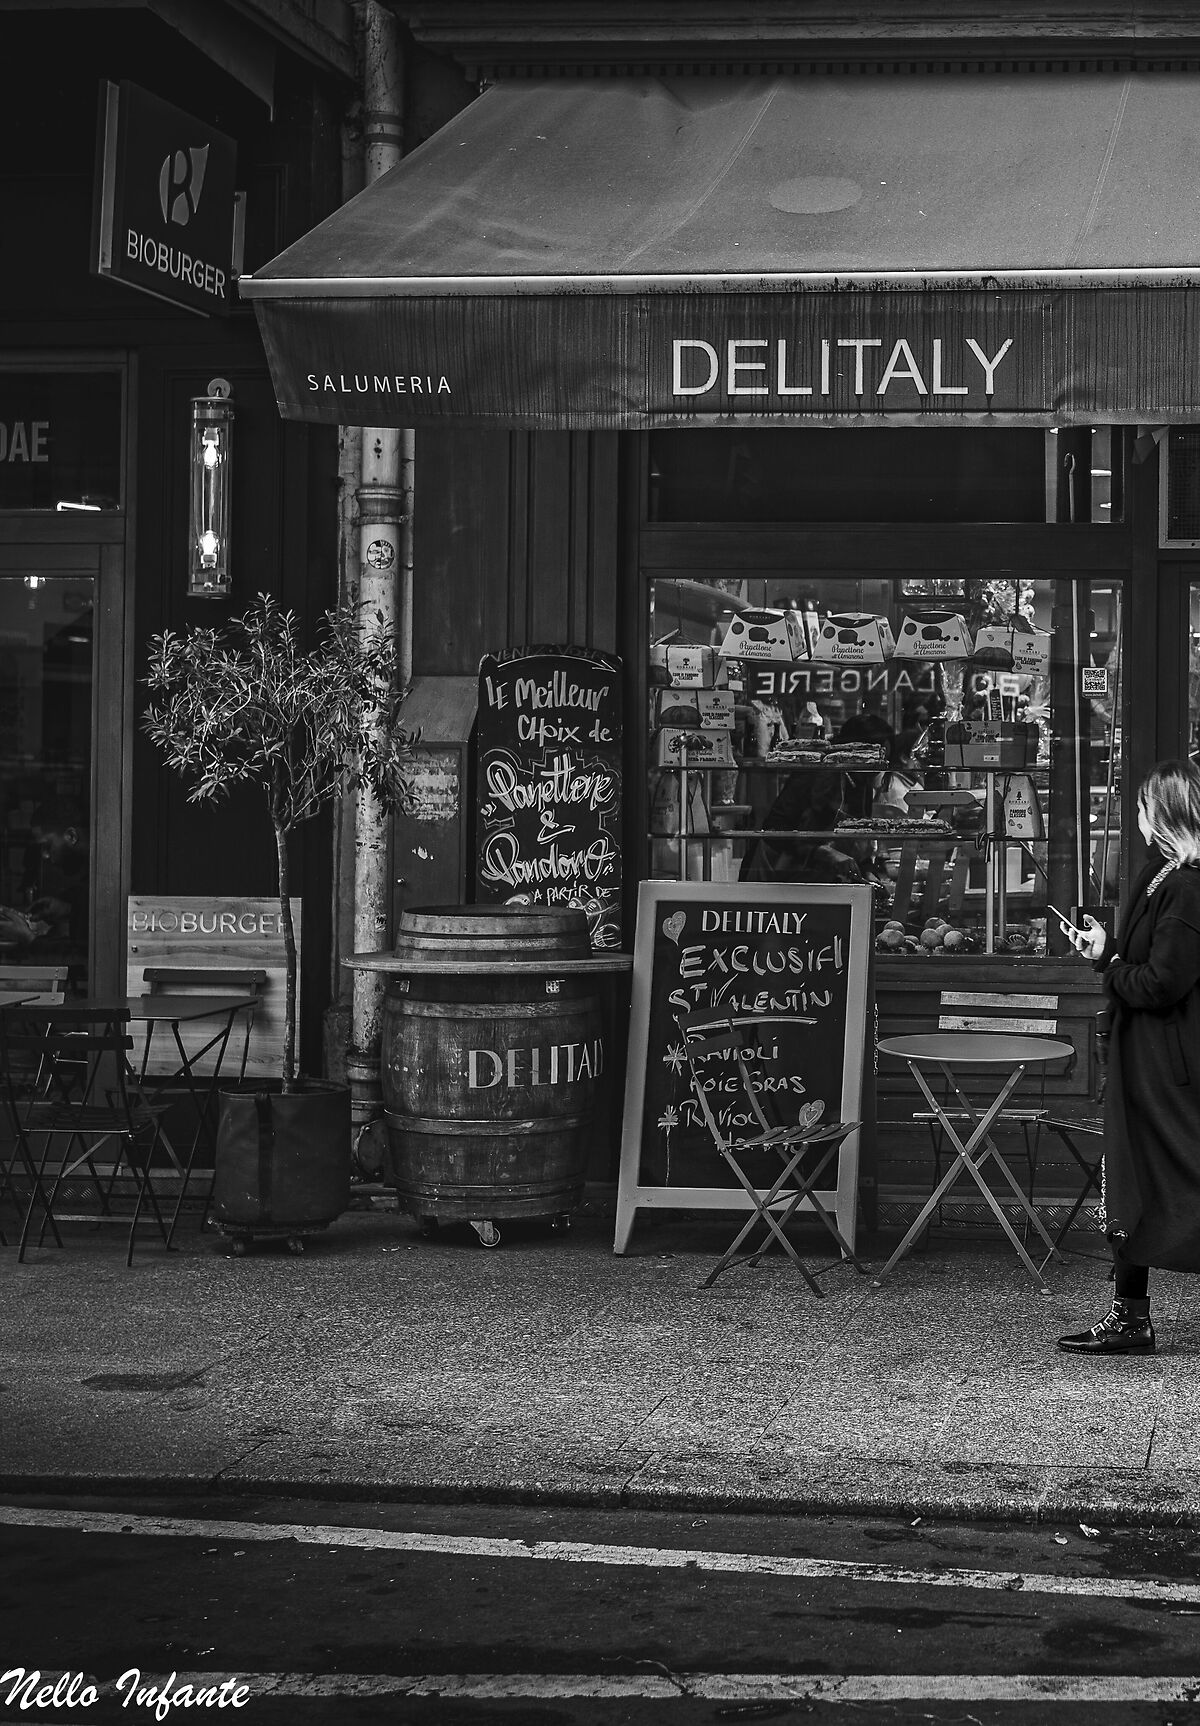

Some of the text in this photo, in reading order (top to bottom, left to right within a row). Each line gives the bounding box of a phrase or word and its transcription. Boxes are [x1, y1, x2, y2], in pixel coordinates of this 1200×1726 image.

[127, 228, 226, 298] BIOBURGER
[307, 374, 452, 394] SALUMERIA
[673, 338, 1014, 396] DELITALY
[515, 670, 610, 711] Meilleur
[589, 719, 613, 742] de
[486, 754, 615, 812] Panettone
[537, 810, 576, 844] &
[596, 885, 619, 899] DE
[702, 910, 807, 934] DELITALY
